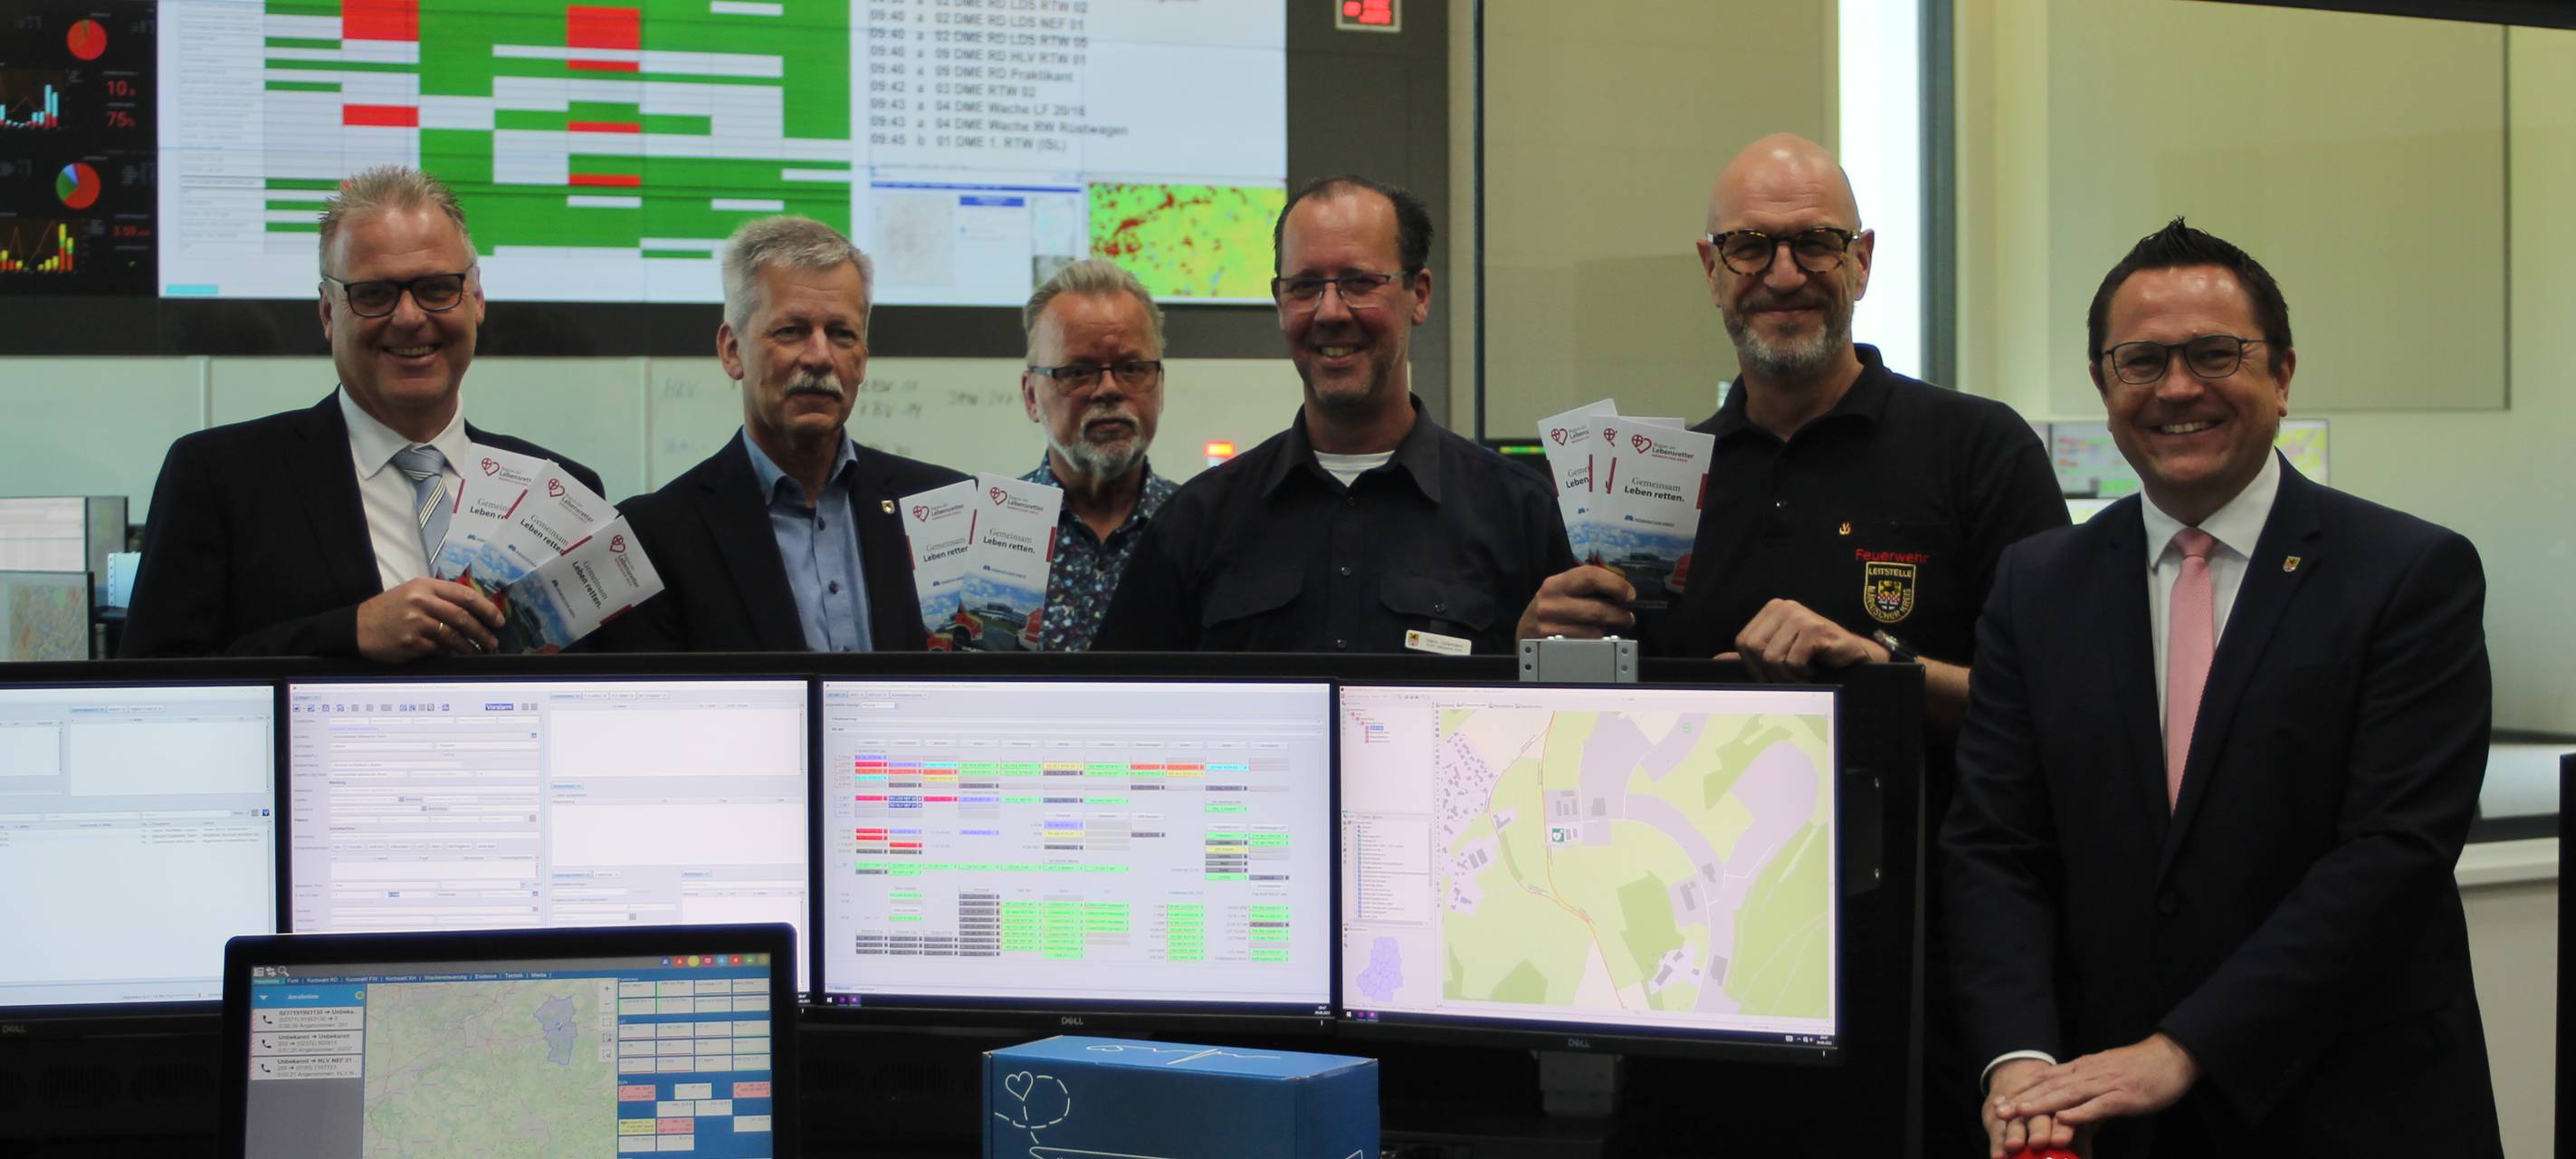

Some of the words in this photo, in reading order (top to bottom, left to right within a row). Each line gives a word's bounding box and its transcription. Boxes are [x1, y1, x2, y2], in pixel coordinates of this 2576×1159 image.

[954, 13, 983, 25] DME
[987, 14, 1007, 26] RD
[1010, 16, 1036, 28] LDS
[1040, 16, 1066, 29] NEF
[954, 30, 983, 43] DME
[987, 32, 1007, 44] RD
[1010, 33, 1036, 45] LDS
[1040, 34, 1070, 47] RTW
[954, 48, 983, 61] DME
[987, 49, 1007, 62] RD
[1040, 52, 1068, 64] RTW
[954, 65, 983, 78] DME
[987, 66, 1007, 80] RD
[1010, 68, 1074, 81] Praktikant
[107, 80, 128, 96] 10
[955, 82, 983, 95] DME
[987, 84, 1017, 97] RTW
[955, 100, 983, 112] DME
[988, 101, 1028, 115] Wache
[1034, 104, 1050, 116] LF
[955, 117, 984, 130] DME
[988, 119, 1028, 132] Wache
[1034, 120, 1054, 133] RW
[956, 135, 985, 148] DME
[1004, 137, 1033, 149] RTW
[1652, 447, 1694, 460] Lebensretter
[1565, 476, 1589, 489] Leben
[1631, 476, 1681, 493] Gemeinsam
[1624, 485, 1652, 497] Leben
[1654, 491, 1685, 503] retten.
[470, 505, 496, 520] Leben
[560, 496, 595, 522] Lebensretter
[931, 503, 965, 517] Lebensretter
[1007, 499, 1045, 512] Lebensretter
[520, 518, 543, 540] Leben
[530, 513, 569, 546] Gemeinsam
[989, 528, 1033, 544] Gemeinsam
[926, 536, 967, 552] Gemeinsam
[983, 535, 1007, 549] Leben
[1008, 542, 1036, 554] retten.
[922, 551, 947, 563] Leben
[1856, 548, 1930, 563] Feuerwehr
[582, 560, 609, 600] Gemeinsam
[1868, 567, 1913, 578] LEITSTELLE
[572, 560, 588, 584] Leben
[585, 582, 602, 609] retten.
[2, 1023, 27, 1033] DELL
[1061, 1016, 1084, 1025] DELL
[1568, 1038, 1591, 1049] DELL
